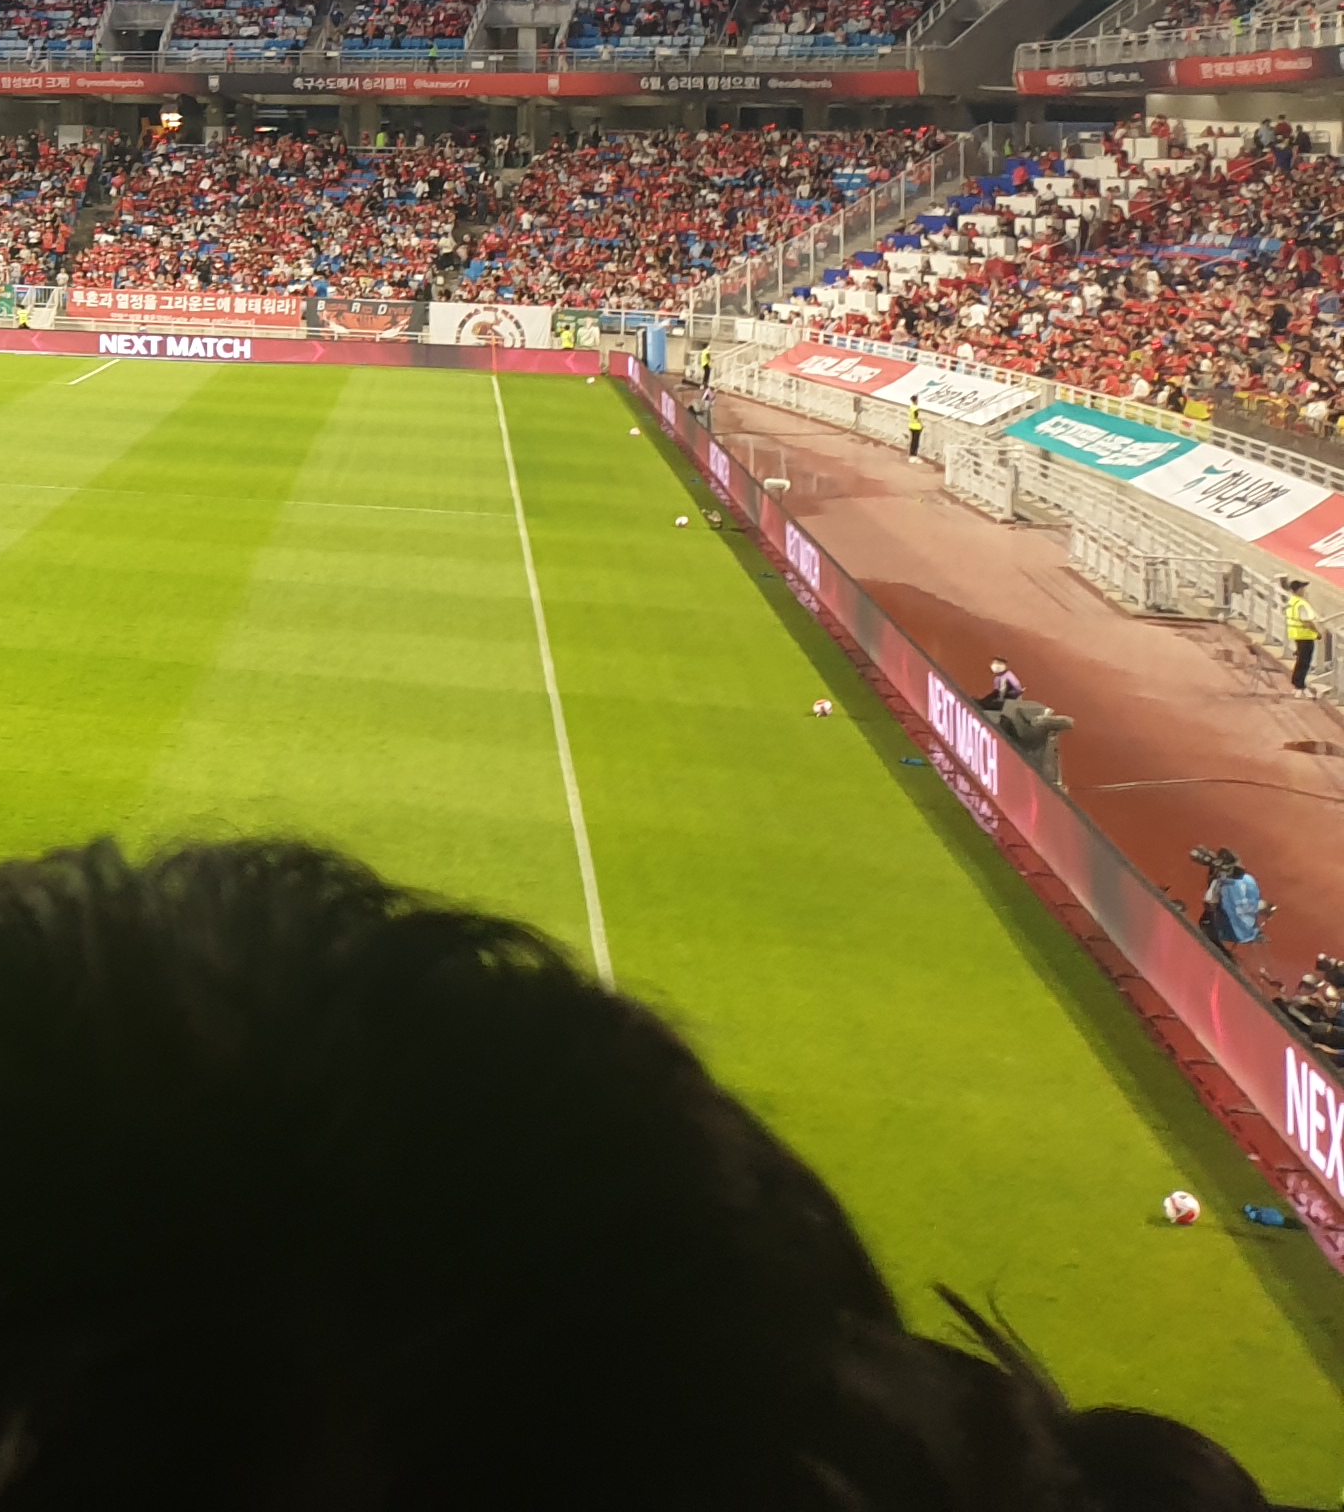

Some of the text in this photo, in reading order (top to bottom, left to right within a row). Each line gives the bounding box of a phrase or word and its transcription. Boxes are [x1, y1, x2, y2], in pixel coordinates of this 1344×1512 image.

[292, 77, 360, 90] 축구수도에서
[668, 76, 704, 90] 승리의
[72, 290, 296, 315] 투혼과 열정을 그라운드에 불태워라!
[99, 334, 251, 359] NEXT MATCH
[927, 670, 998, 796] NEXT MATCH
